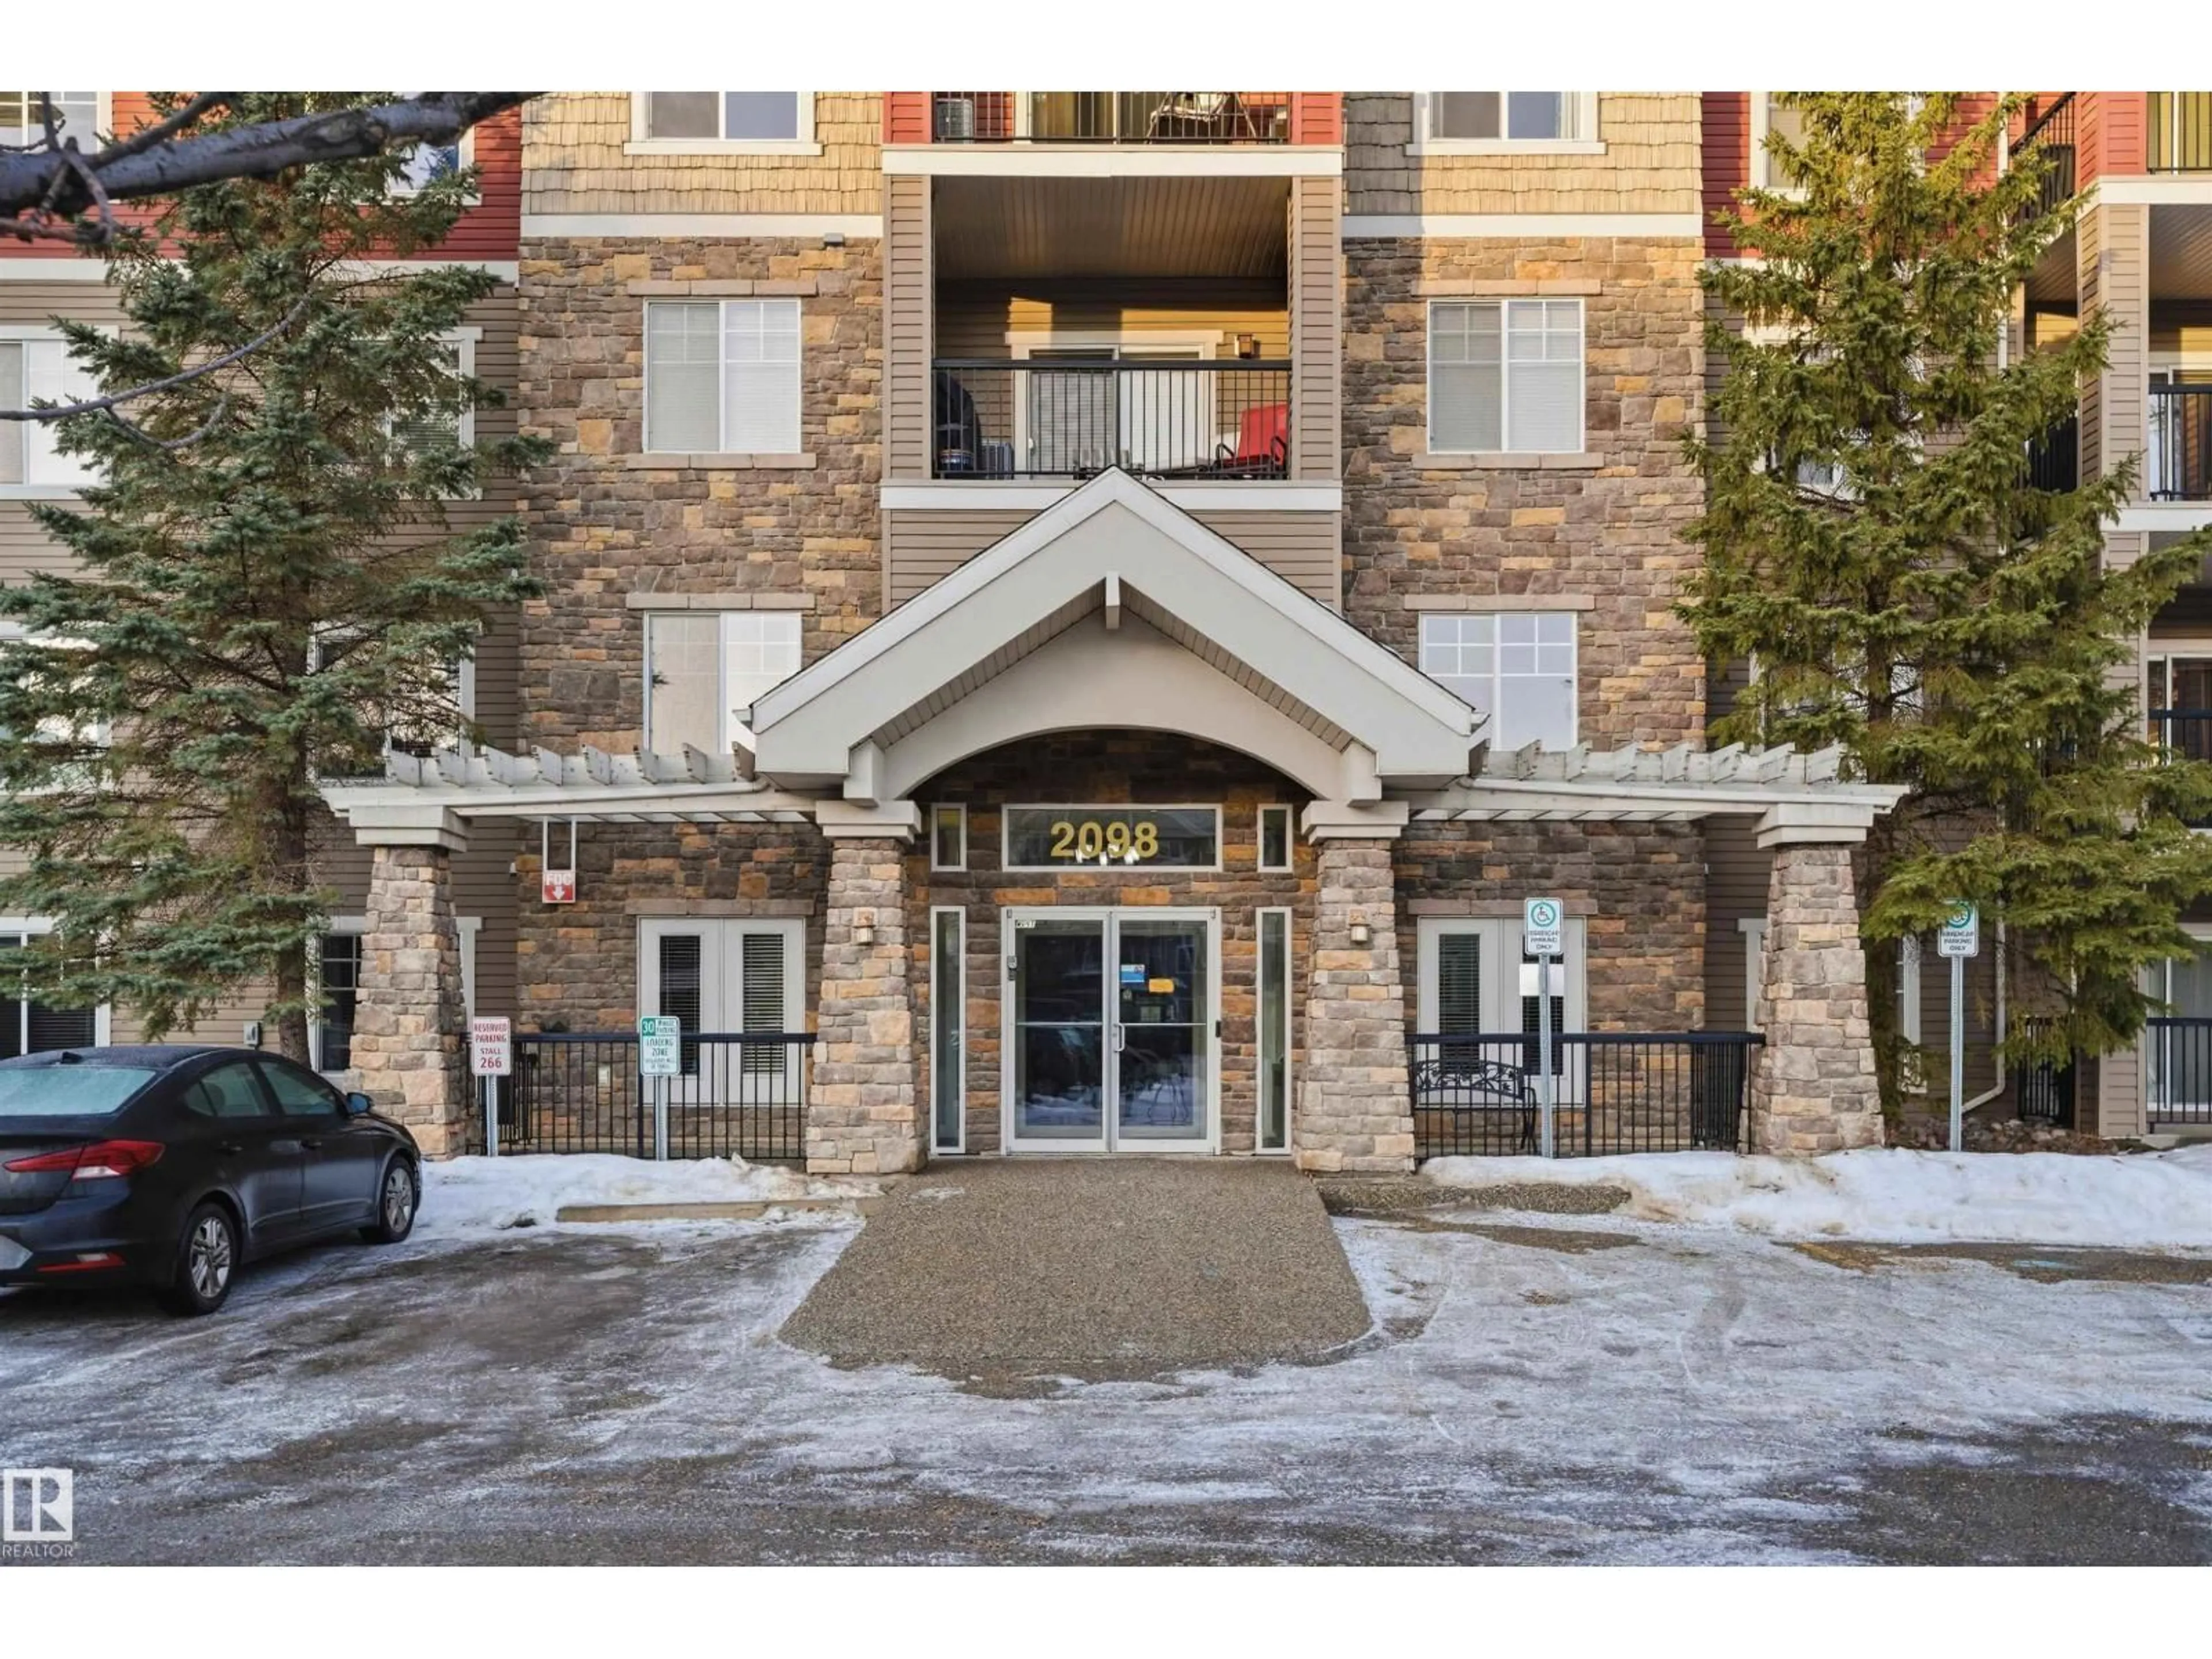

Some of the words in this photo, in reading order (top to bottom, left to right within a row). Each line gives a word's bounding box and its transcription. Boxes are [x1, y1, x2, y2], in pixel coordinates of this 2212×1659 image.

[1050, 821, 1159, 858] 2098
[474, 1022, 507, 1032] RESERVED
[642, 1020, 654, 1034] 30
[475, 1033, 507, 1043] PARKING
[480, 1057, 502, 1069] 266
